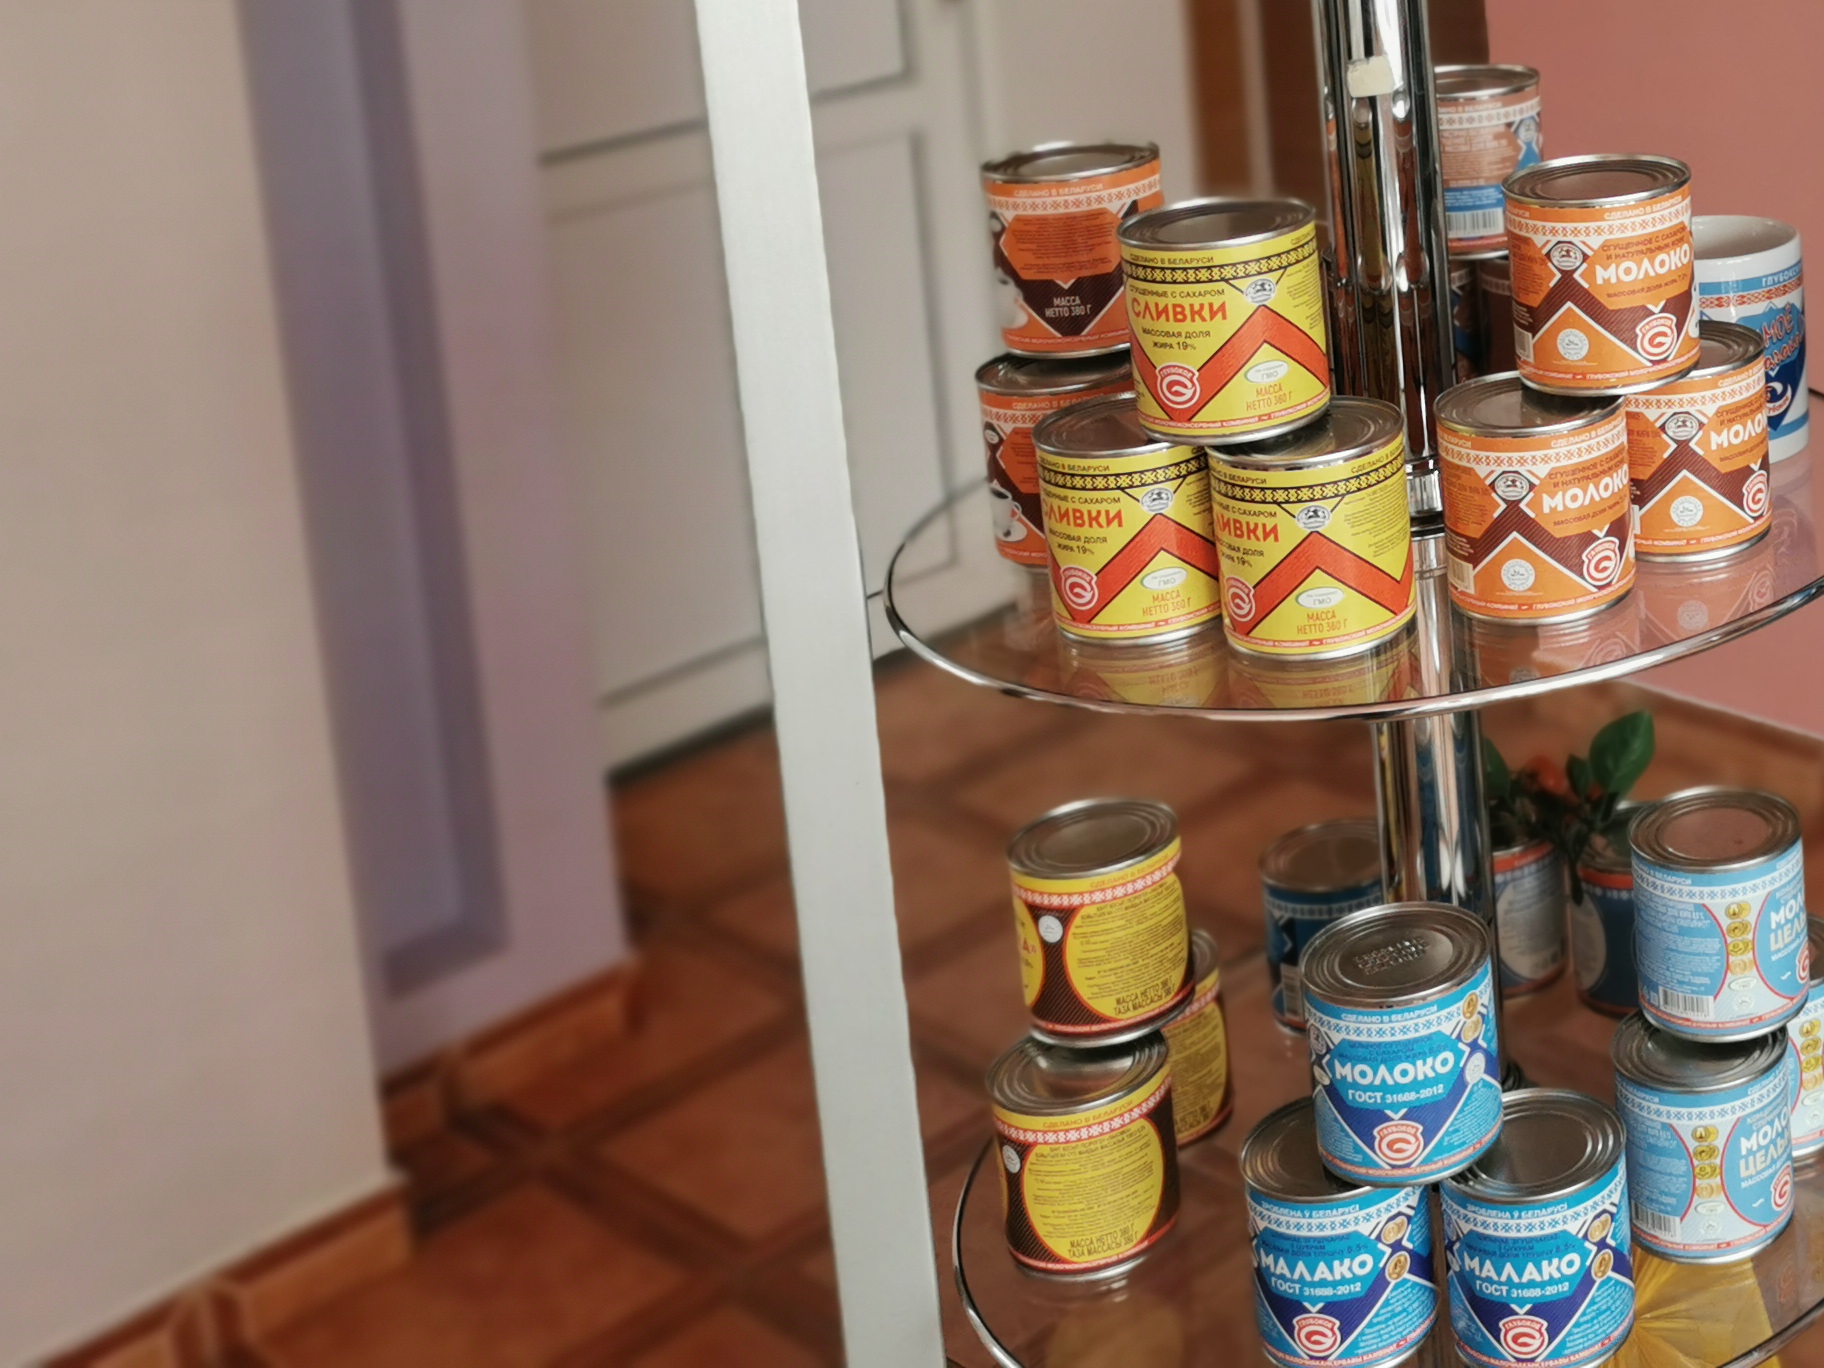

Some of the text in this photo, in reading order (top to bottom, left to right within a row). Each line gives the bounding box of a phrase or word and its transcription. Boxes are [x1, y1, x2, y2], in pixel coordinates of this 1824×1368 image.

[1014, 189, 1049, 197] СДЕЛАНО
[1059, 184, 1103, 195] БЕЛАРУСИ
[1167, 257, 1214, 265] БЕЛАРУСИ
[1595, 243, 1690, 285] МОЛОКО
[1053, 296, 1080, 306] МАССА
[1181, 289, 1225, 299] САХАРОМ
[1045, 308, 1069, 317] НЕТТО
[1071, 306, 1085, 316] 380
[1132, 298, 1227, 323] СЛИВКИ
[1142, 329, 1211, 339] МАССОВАЯ ДОЛЯ
[1176, 342, 1196, 351] 19%
[1256, 383, 1283, 397] МАССА
[1246, 398, 1273, 411] НЕТТО
[1274, 395, 1288, 406] 380
[1551, 433, 1590, 447] СДЕЛАНО
[1067, 463, 1111, 473] БЕЛАРУСИ
[1542, 463, 1629, 513] МОЛОКО
[1078, 494, 1121, 505] САХАРОМ
[1237, 508, 1277, 518] САХАРОМ
[1217, 513, 1279, 543] ЛИВКИ
[1084, 533, 1108, 544] ДОЛЯ
[1242, 548, 1265, 557] ДОЛЯ
[1152, 590, 1181, 604] МАССА
[1142, 604, 1170, 617] НЕТТО
[1307, 610, 1336, 620] МАССА
[1297, 624, 1324, 635] НЕТТО
[1770, 892, 1803, 930] МОЛ
[1115, 983, 1159, 1006] МАССА НЕТТО
[1113, 1002, 1132, 1016] ТАЗА
[1341, 1013, 1381, 1024] СДЕЛАНО
[1392, 1005, 1438, 1022] БЕЛАРУСИ
[1334, 1051, 1455, 1086] МОЛОКО
[1348, 1084, 1445, 1104] ГОСТ 31688-2012
[1043, 1118, 1083, 1128] СДЕЛАНО
[1092, 1099, 1134, 1123] БЕЛАРУСИ
[1740, 1106, 1788, 1156] МОЛО
[1312, 1204, 1360, 1218] БЕЛАРУСІ
[1521, 1202, 1568, 1218] БЕЛАРУСІ
[1070, 1237, 1094, 1249] МАССА
[1095, 1232, 1118, 1245] НЕТТО
[1068, 1247, 1086, 1259] ТАЗА
[1087, 1240, 1123, 1256] МАССАСЫ
[1260, 1248, 1373, 1282] МАЛАКО
[1464, 1251, 1581, 1283] МАЛАКО
[1271, 1279, 1361, 1296] ГОСТ 31688-2012
[1476, 1280, 1570, 1298] ГОСТ 31688-2012
[1504, 1319, 1541, 1331] ГЛУБОКОЕ
